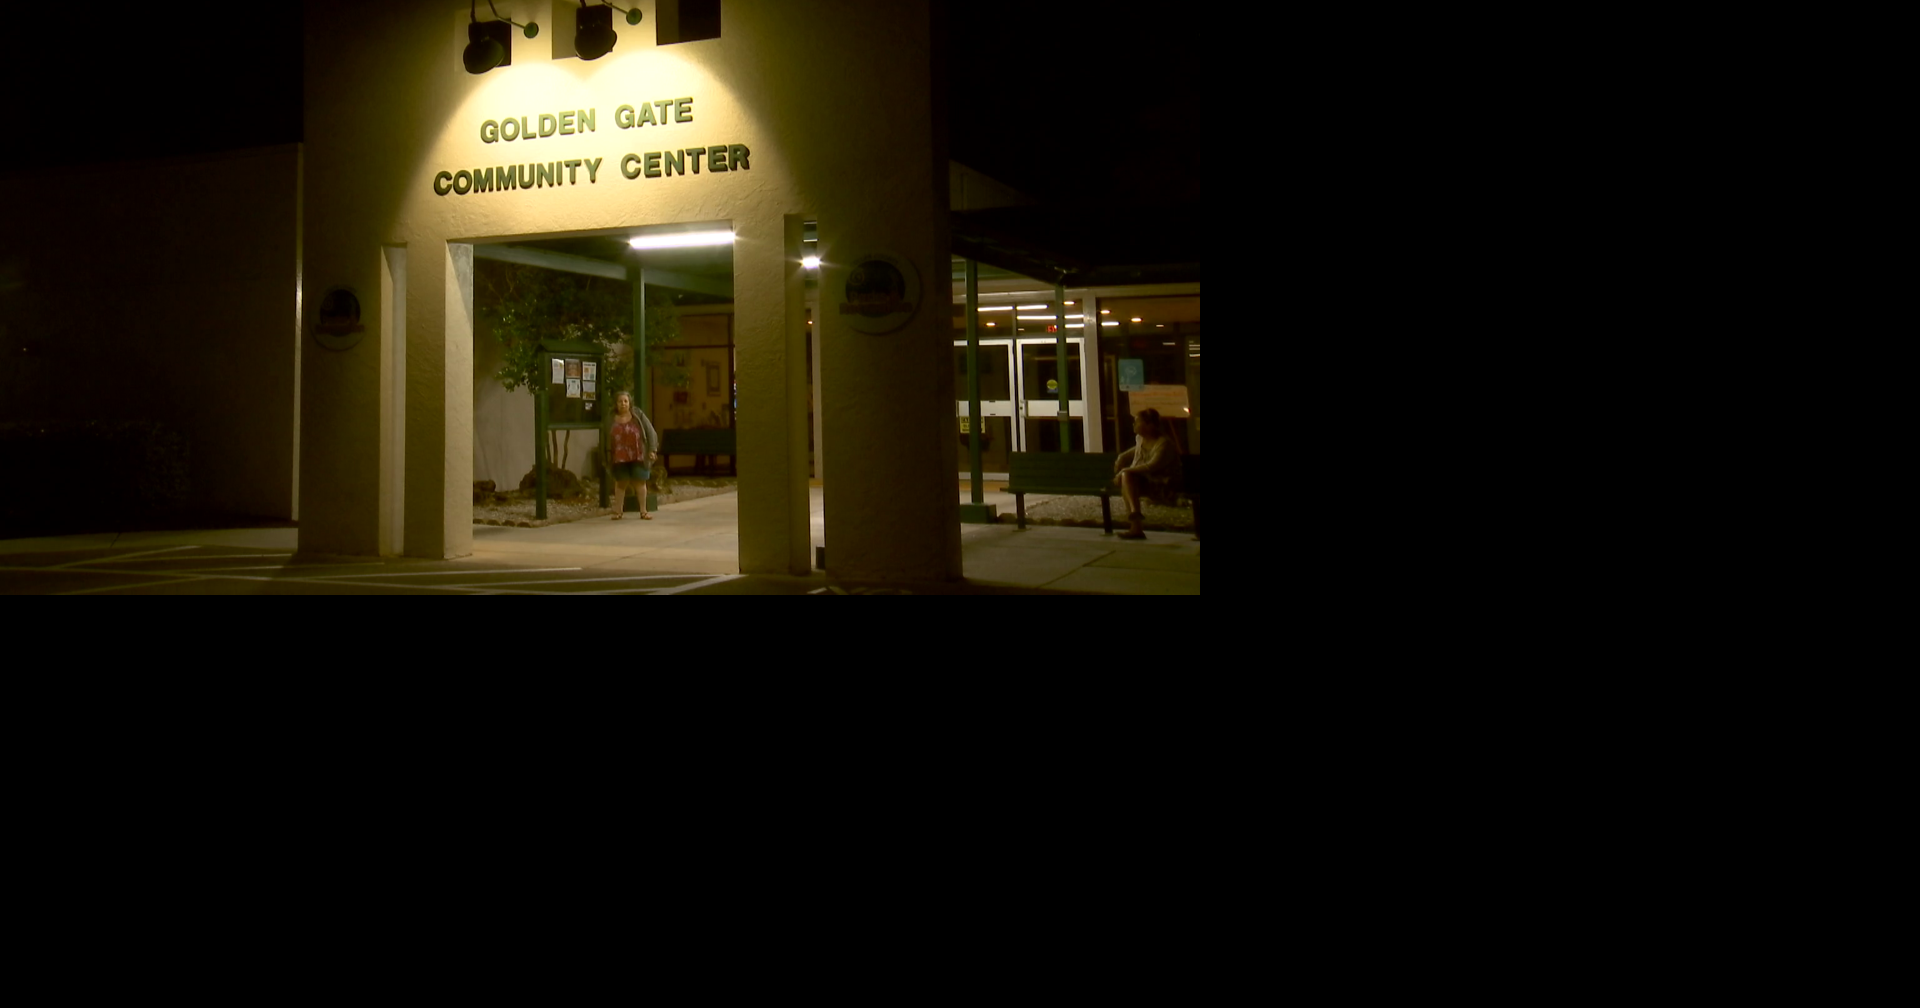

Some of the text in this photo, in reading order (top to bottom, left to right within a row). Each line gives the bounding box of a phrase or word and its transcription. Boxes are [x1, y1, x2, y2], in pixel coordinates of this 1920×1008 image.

[480, 97, 694, 144] GOLDEN GATE
[433, 143, 751, 196] COMMUNITY CENTER
